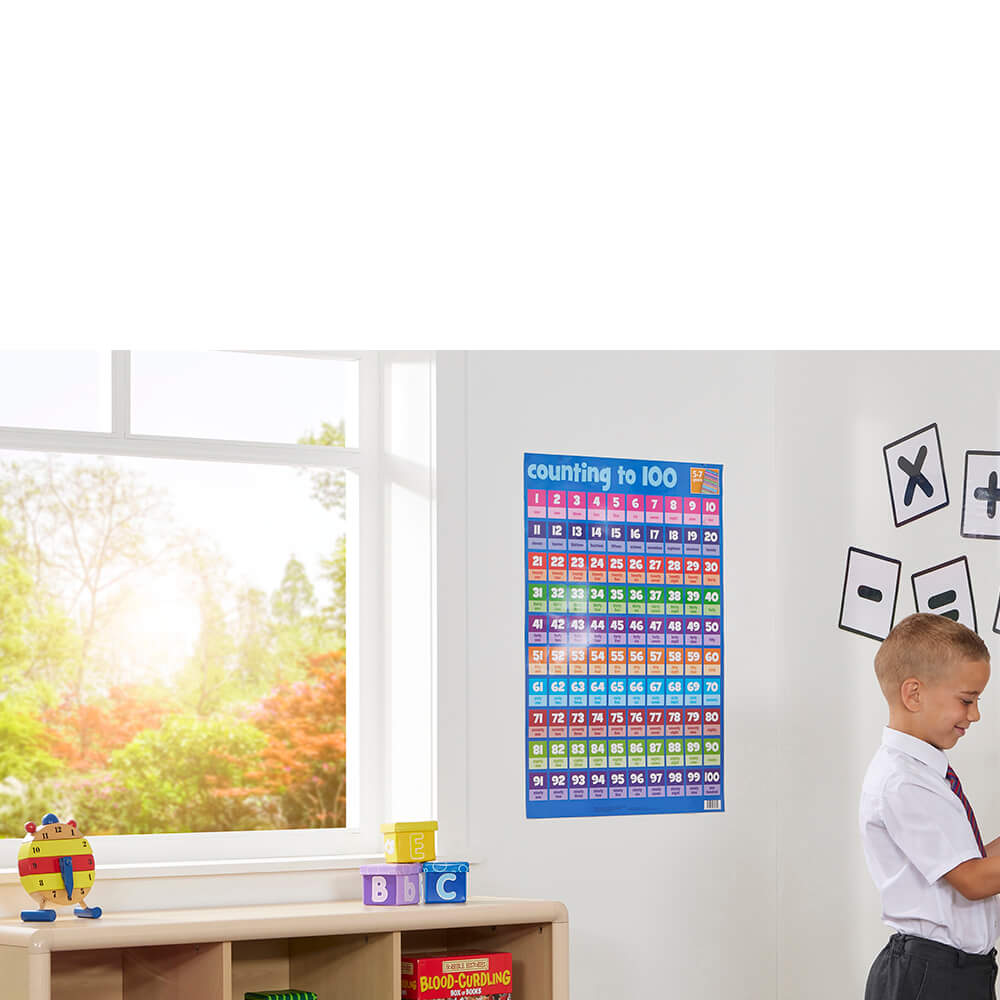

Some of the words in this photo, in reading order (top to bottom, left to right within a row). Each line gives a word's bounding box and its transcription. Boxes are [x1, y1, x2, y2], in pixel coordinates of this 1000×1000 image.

[527, 462, 612, 491] counting
[618, 466, 636, 485] to
[642, 466, 678, 488] 100
[705, 501, 716, 513] 10
[533, 524, 541, 535] 11
[552, 525, 562, 536] 12
[572, 526, 583, 537] 13
[591, 526, 602, 538] 14
[611, 527, 621, 539] 15
[630, 528, 641, 540] 16
[650, 529, 660, 540] 17
[669, 530, 679, 541] 18
[687, 530, 698, 541] 19
[704, 531, 718, 543] 20
[532, 555, 543, 567] 21
[550, 556, 565, 568] 22
[570, 556, 585, 569] 23
[590, 557, 604, 569] 24
[610, 558, 624, 570] 25
[629, 558, 643, 570] 26
[649, 559, 662, 571] 27
[667, 559, 681, 571] 28
[686, 560, 700, 572] 29
[704, 561, 719, 573] 30
[532, 586, 543, 598] 31
[551, 587, 565, 599] 32
[590, 588, 605, 600] 34
[610, 588, 624, 601] 35
[629, 589, 644, 601] 36
[649, 589, 662, 601] 37
[668, 590, 681, 602] 38
[686, 590, 700, 602] 39
[704, 591, 719, 602] 40
[532, 618, 543, 630] 41
[550, 618, 566, 630] 42
[590, 619, 605, 632] 44
[610, 619, 625, 631] 45
[629, 620, 644, 631] 46
[649, 620, 662, 631] 47
[668, 620, 682, 632] 48
[686, 621, 700, 632] 49
[705, 621, 719, 633] 50
[532, 650, 544, 662] 51
[591, 650, 605, 662] 54
[610, 650, 625, 662] 55
[630, 650, 644, 662] 56
[649, 650, 663, 662] 57
[668, 651, 682, 662] 58
[687, 651, 701, 662] 59
[704, 651, 720, 663] 60
[532, 681, 544, 693] 61
[550, 681, 566, 693] 62
[570, 681, 585, 693] 63
[590, 681, 605, 693] 64
[610, 681, 625, 693] 65
[629, 681, 644, 693] 66
[649, 681, 662, 693] 67
[667, 681, 682, 693] 68
[686, 681, 701, 692] 69
[706, 681, 719, 693] 70
[533, 713, 543, 724] 71
[551, 712, 565, 724] 72
[572, 712, 585, 724] 73
[591, 712, 604, 723] 74
[610, 712, 624, 723] 75
[630, 711, 643, 723] 76
[649, 712, 662, 723] 77
[668, 711, 681, 723] 78
[687, 711, 700, 722] 79
[705, 711, 719, 722] 80
[532, 744, 544, 756] 81
[551, 743, 566, 755] 82
[571, 743, 585, 755] 83
[591, 743, 605, 754] 84
[610, 743, 625, 754] 85
[629, 742, 644, 754] 86
[649, 742, 662, 753] 87
[668, 741, 682, 753] 88
[686, 741, 700, 753] 89
[704, 741, 719, 753] 90
[533, 775, 544, 787] 91
[551, 774, 566, 786] 92
[571, 774, 586, 786] 93
[591, 774, 605, 785] 94
[611, 773, 625, 785] 95
[630, 773, 645, 784] 96
[649, 772, 663, 784] 97
[668, 772, 682, 783] 98
[687, 771, 701, 782] 99
[704, 771, 720, 782] 100
[409, 832, 424, 860] E
[371, 876, 388, 903] B
[436, 872, 457, 900] C
[420, 969, 511, 993] BLOOD-CURDLING
